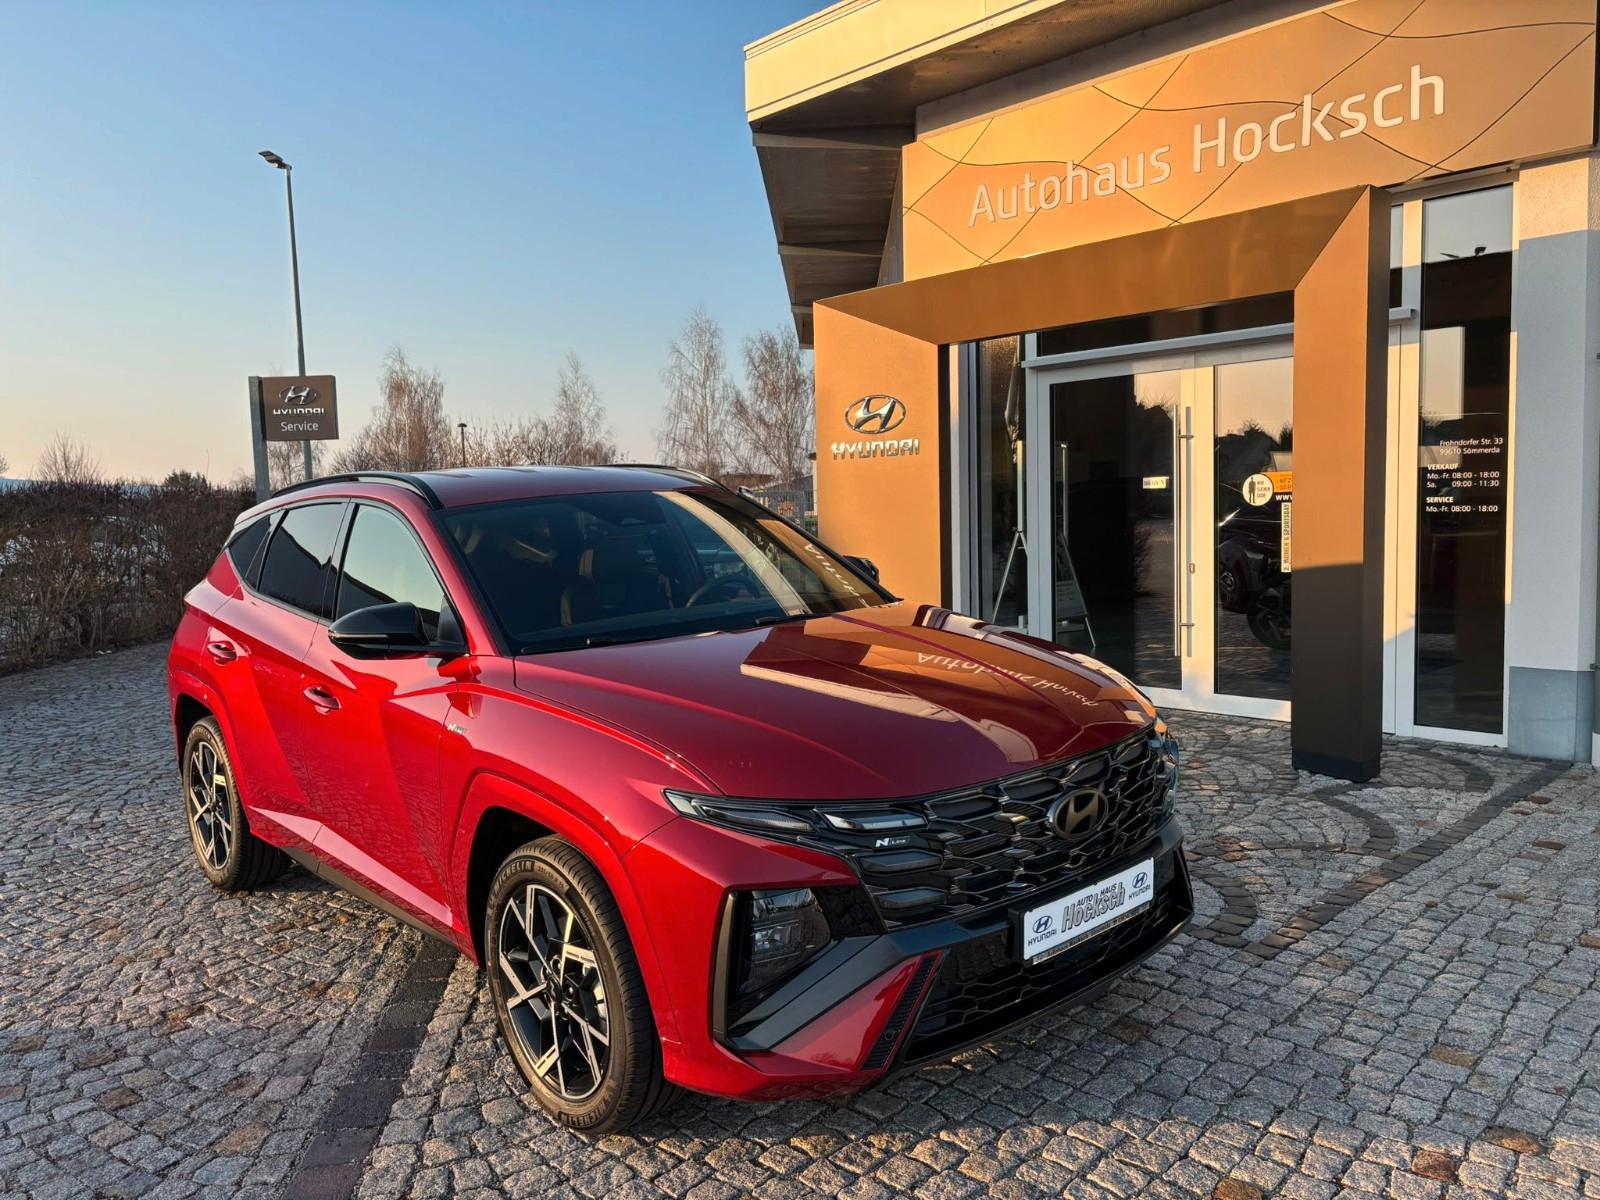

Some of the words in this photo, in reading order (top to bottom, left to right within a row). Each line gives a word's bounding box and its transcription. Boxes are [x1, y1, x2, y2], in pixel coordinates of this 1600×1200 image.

[967, 145, 1172, 228] Autohaus
[1192, 64, 1446, 174] Hocksch
[280, 421, 319, 432] Service
[1493, 437, 1504, 445] 33
[831, 439, 920, 461] HYUNDAI
[1427, 463, 1459, 471] VERKAUF
[1479, 471, 1499, 479] 18:00
[876, 837, 890, 847] N
[1076, 893, 1095, 907] AUTO
[1100, 882, 1117, 897] HAUS
[1129, 884, 1151, 901] HYUNDAI
[1061, 881, 1126, 934] Hocksch
[1028, 927, 1058, 947] HYUNDAI
